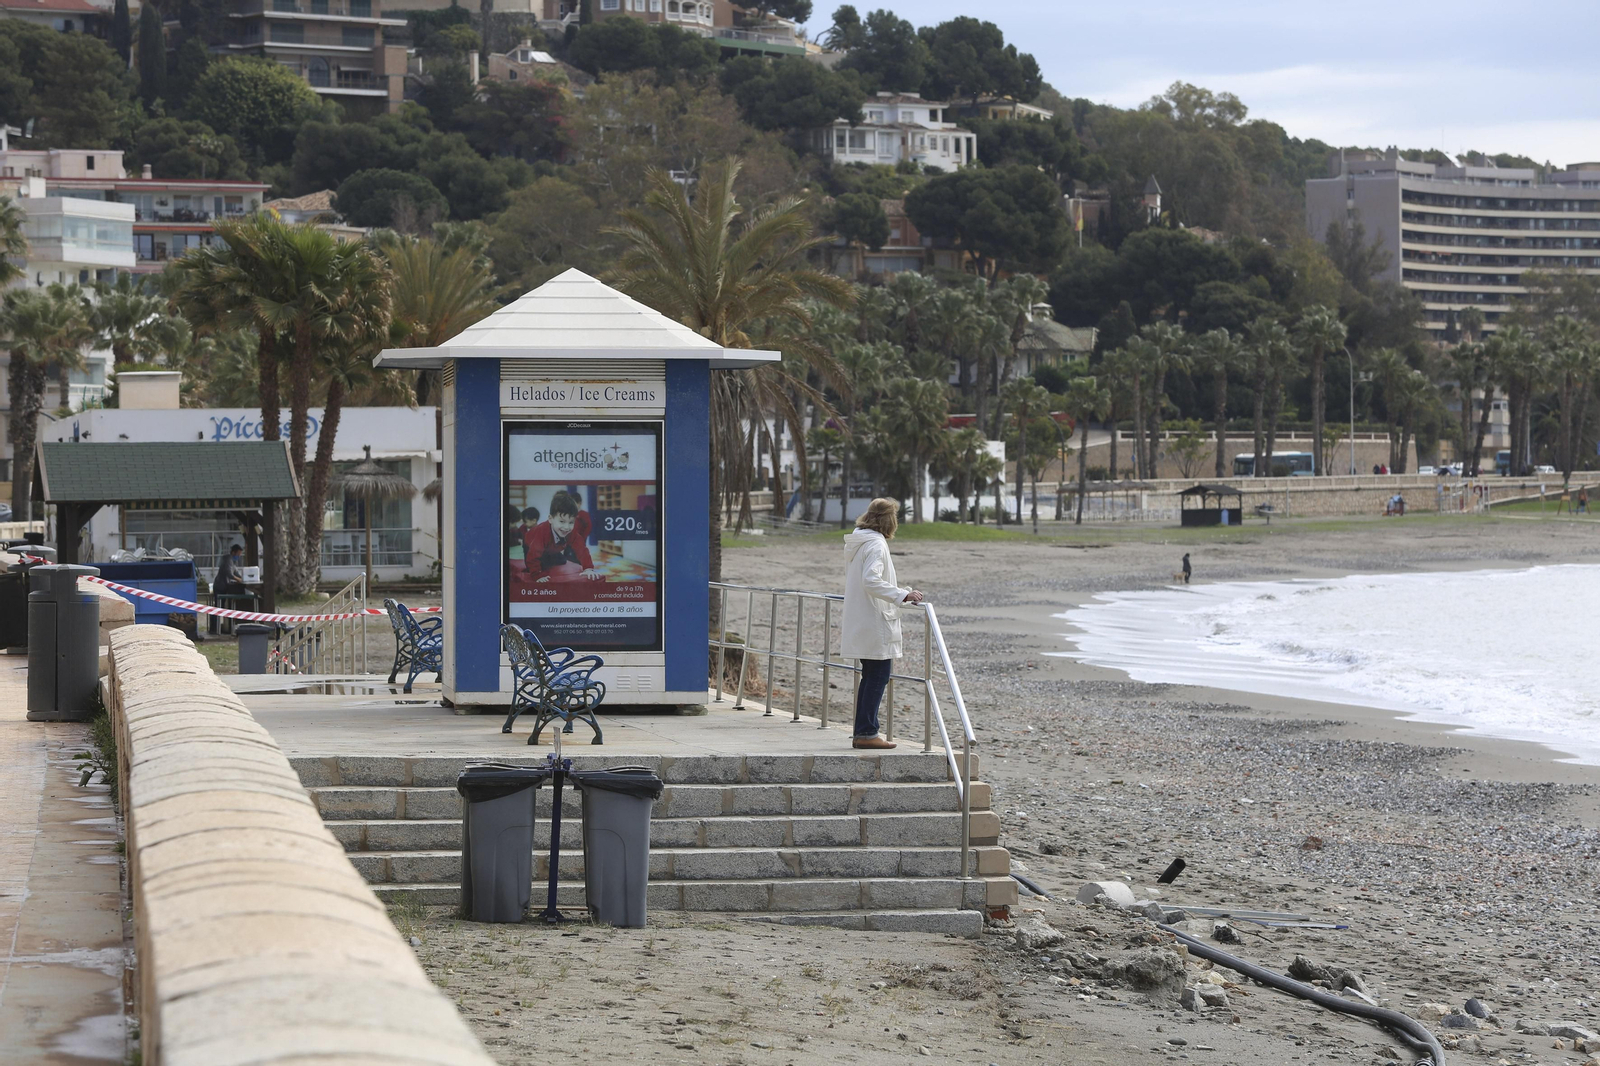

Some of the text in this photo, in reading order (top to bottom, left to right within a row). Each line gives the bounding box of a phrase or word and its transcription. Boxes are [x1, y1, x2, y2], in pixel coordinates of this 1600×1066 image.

[510, 386, 566, 401] Helados
[579, 386, 600, 401] Ice
[604, 386, 656, 401] Creams
[533, 448, 598, 463] attendis
[558, 461, 604, 470] preschool
[521, 588, 526, 596] 0
[534, 588, 539, 596] 2
[540, 588, 557, 596] años
[548, 605, 558, 613] Un
[559, 606, 590, 615] proyecto
[592, 605, 601, 613] de
[618, 605, 625, 613] 18
[626, 605, 644, 613] años
